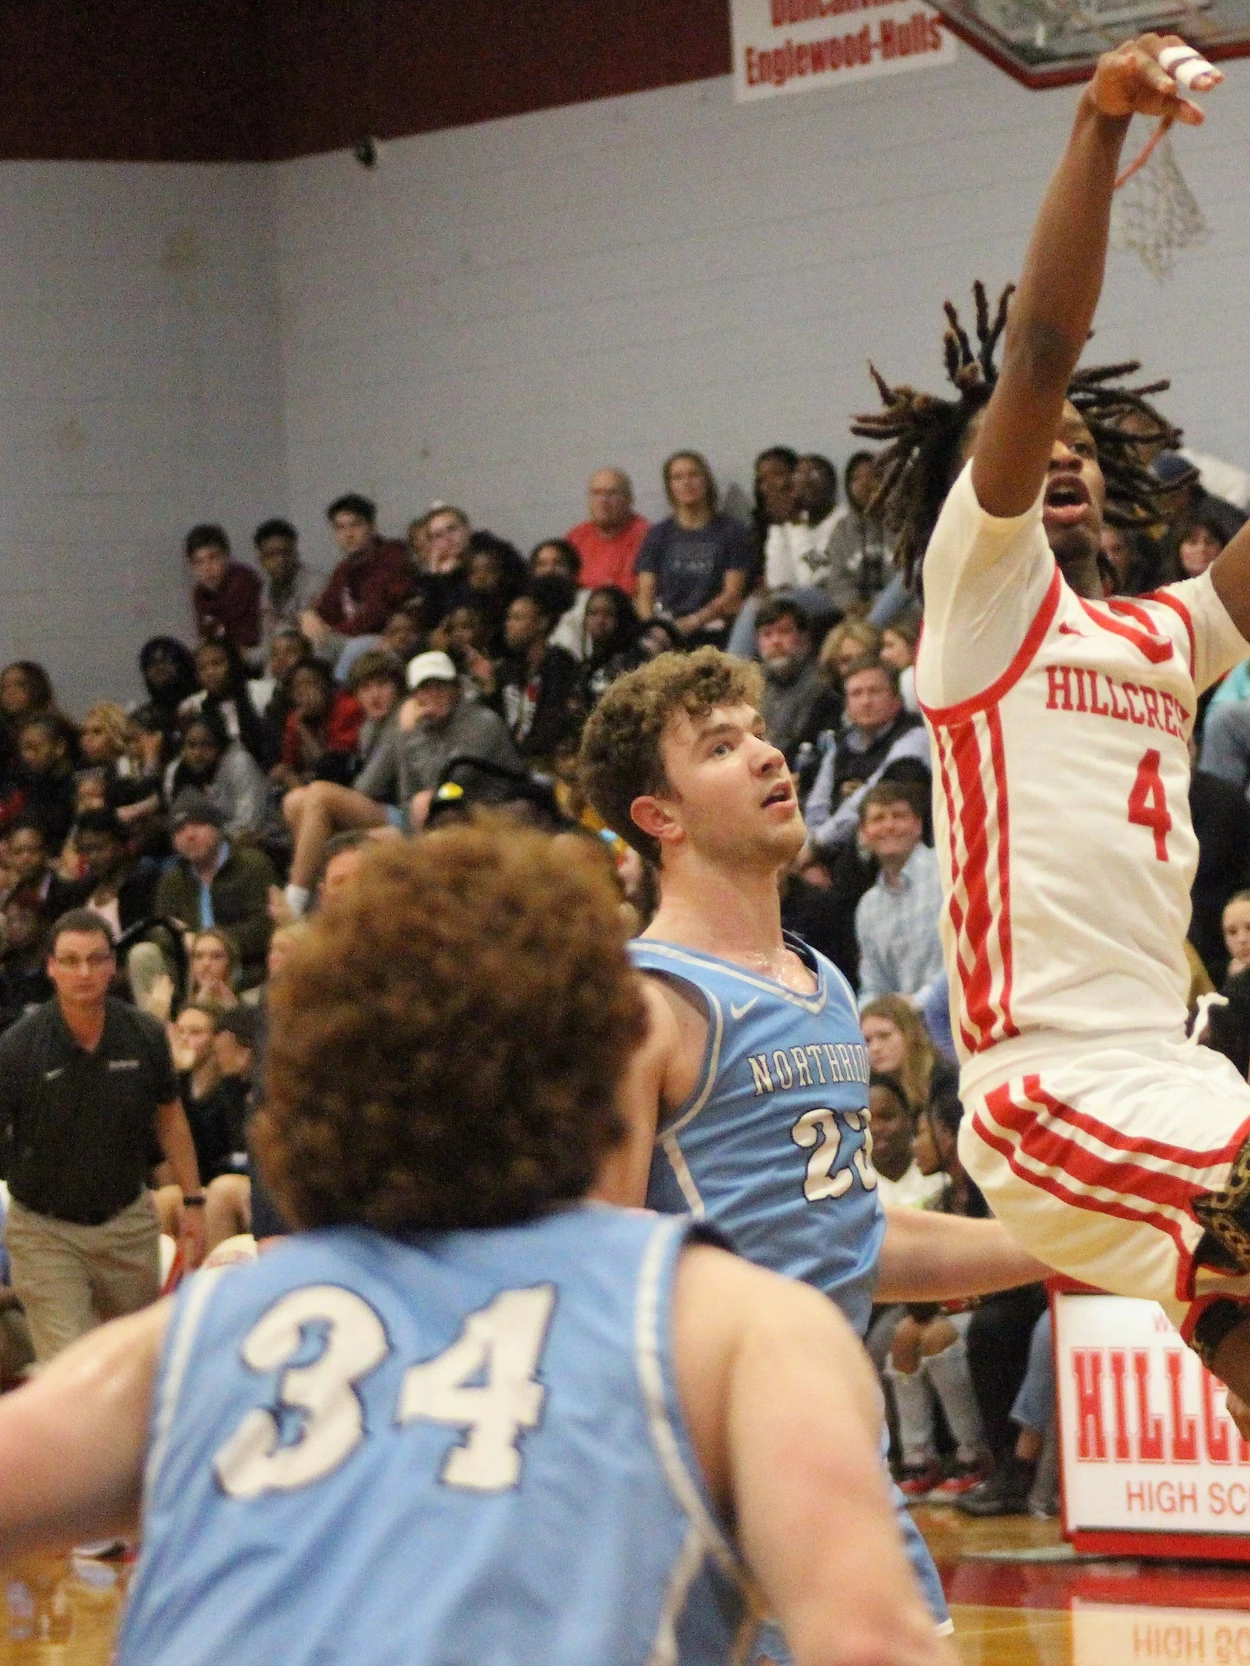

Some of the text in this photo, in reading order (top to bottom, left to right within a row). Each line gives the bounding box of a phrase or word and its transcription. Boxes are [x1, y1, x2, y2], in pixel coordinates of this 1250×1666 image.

[1128, 748, 1172, 862] 4
[211, 1279, 556, 1498] 34
[1125, 1480, 1199, 1513] HIGH
